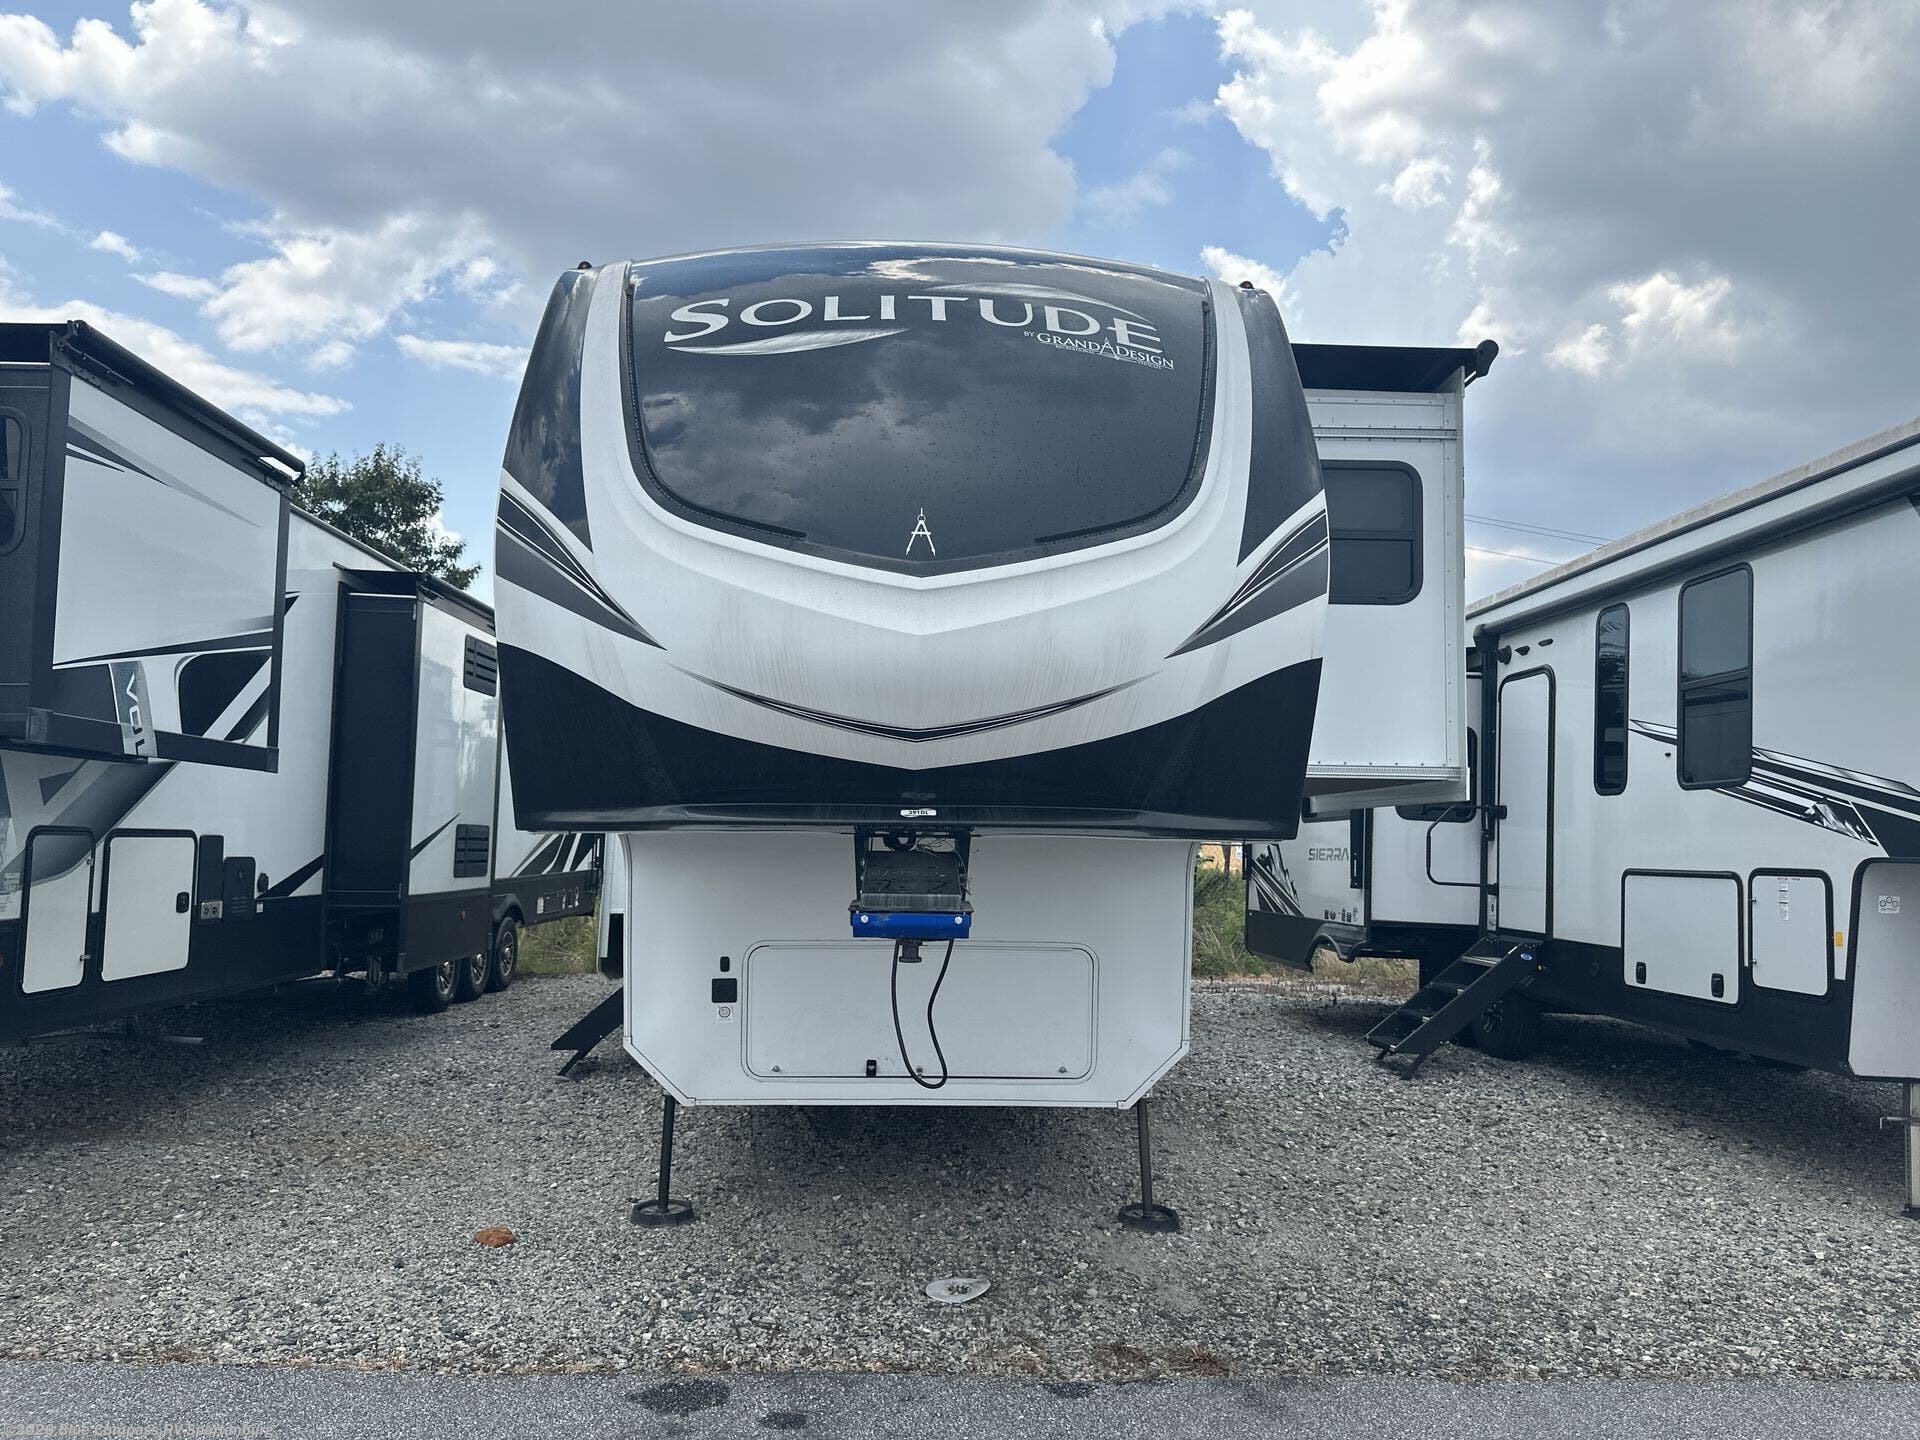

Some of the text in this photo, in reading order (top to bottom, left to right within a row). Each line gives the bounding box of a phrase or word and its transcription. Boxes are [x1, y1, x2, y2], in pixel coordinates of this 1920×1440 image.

[664, 295, 1163, 354] SOLITUDE
[1023, 330, 1036, 338] BY
[1308, 847, 1350, 862] SIERRA
